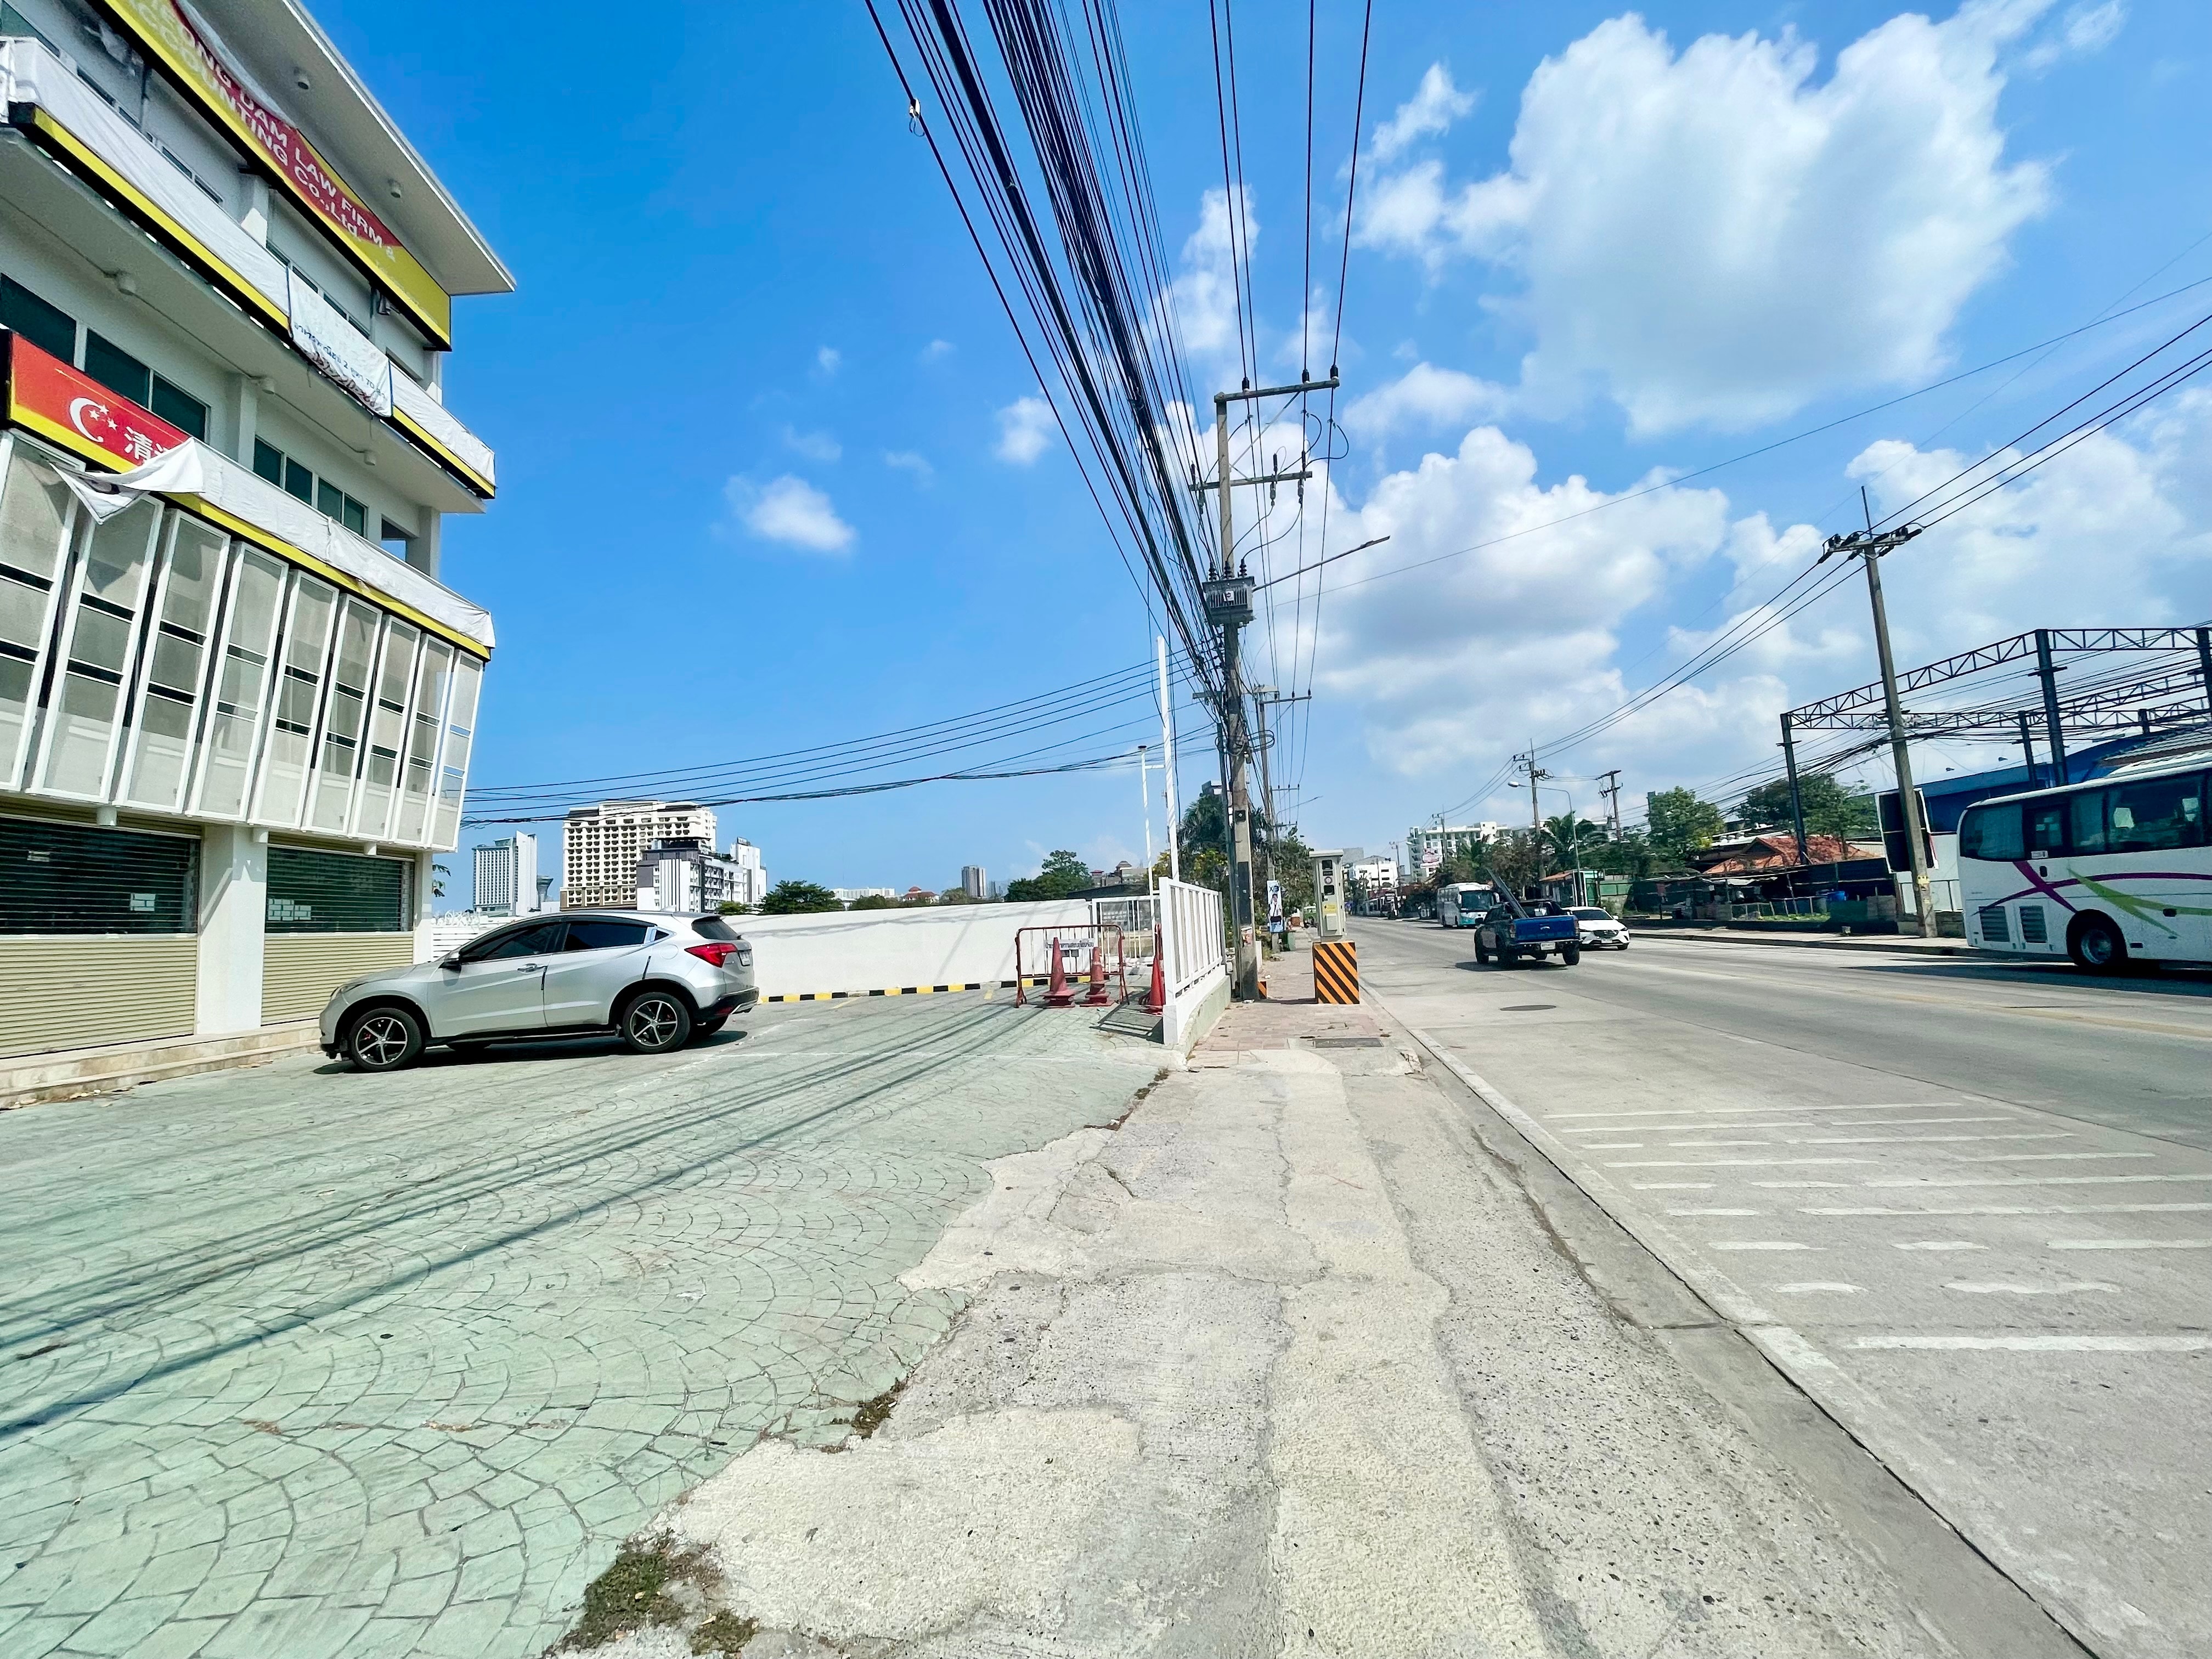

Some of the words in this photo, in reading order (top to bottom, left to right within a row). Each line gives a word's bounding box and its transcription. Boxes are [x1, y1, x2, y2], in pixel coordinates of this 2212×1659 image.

[295, 147, 337, 198] LAW
[341, 197, 383, 248] FIRM
[386, 246, 396, 263] &
